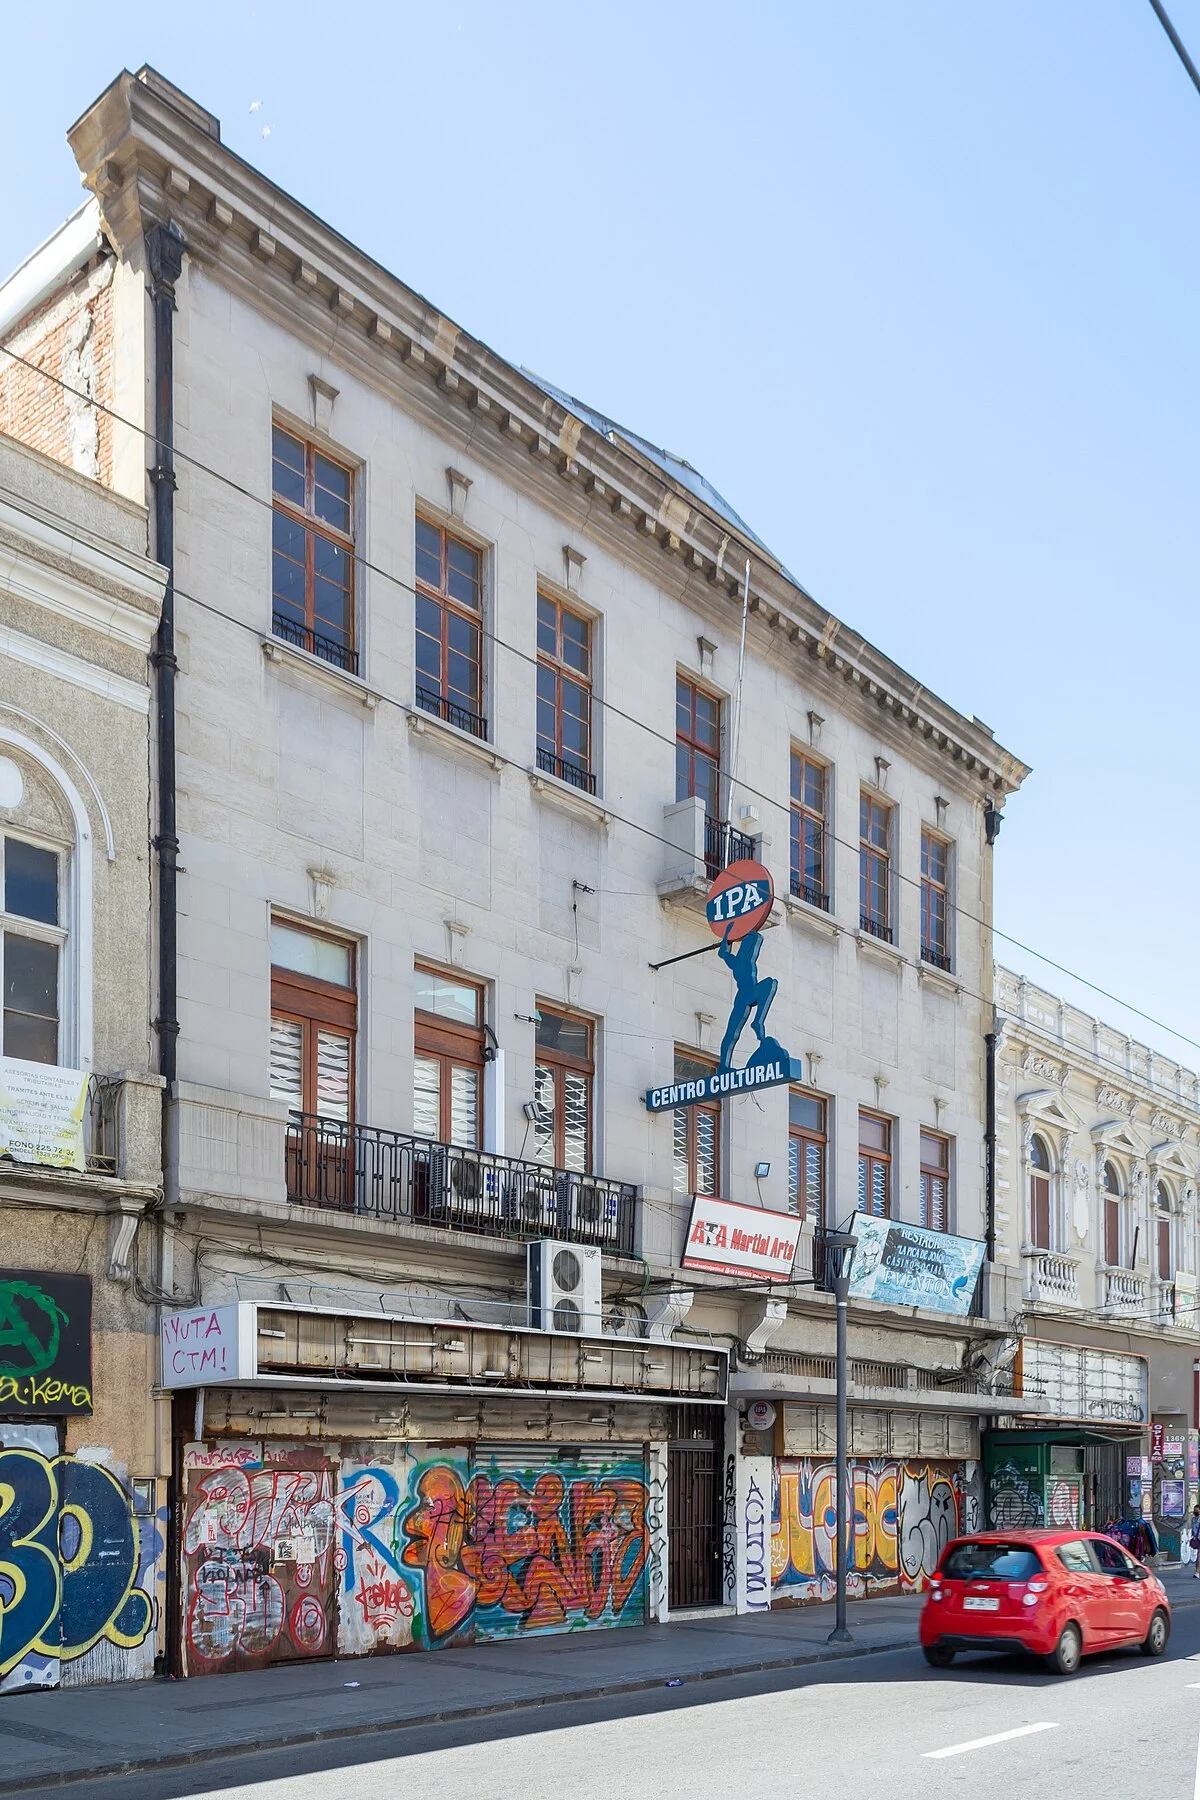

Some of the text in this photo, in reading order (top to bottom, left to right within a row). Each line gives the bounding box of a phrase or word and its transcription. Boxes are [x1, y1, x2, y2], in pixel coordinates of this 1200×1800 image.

[713, 882, 763, 921] IPA
[7, 1086, 38, 1095] TRAMITES
[40, 1075, 74, 1086] CONTABLES
[652, 1061, 784, 1108] CENTRO CULTURAL
[9, 1140, 34, 1149] FONO
[36, 1144, 51, 1152] 225
[691, 1220, 795, 1260] ATA Martial Arts
[886, 1256, 915, 1270] CASINO
[915, 1261, 942, 1275] SOCIAL
[883, 1270, 951, 1296] EVENTOS
[172, 1347, 226, 1374] CTM!
[1152, 1424, 1162, 1456] OPTICA
